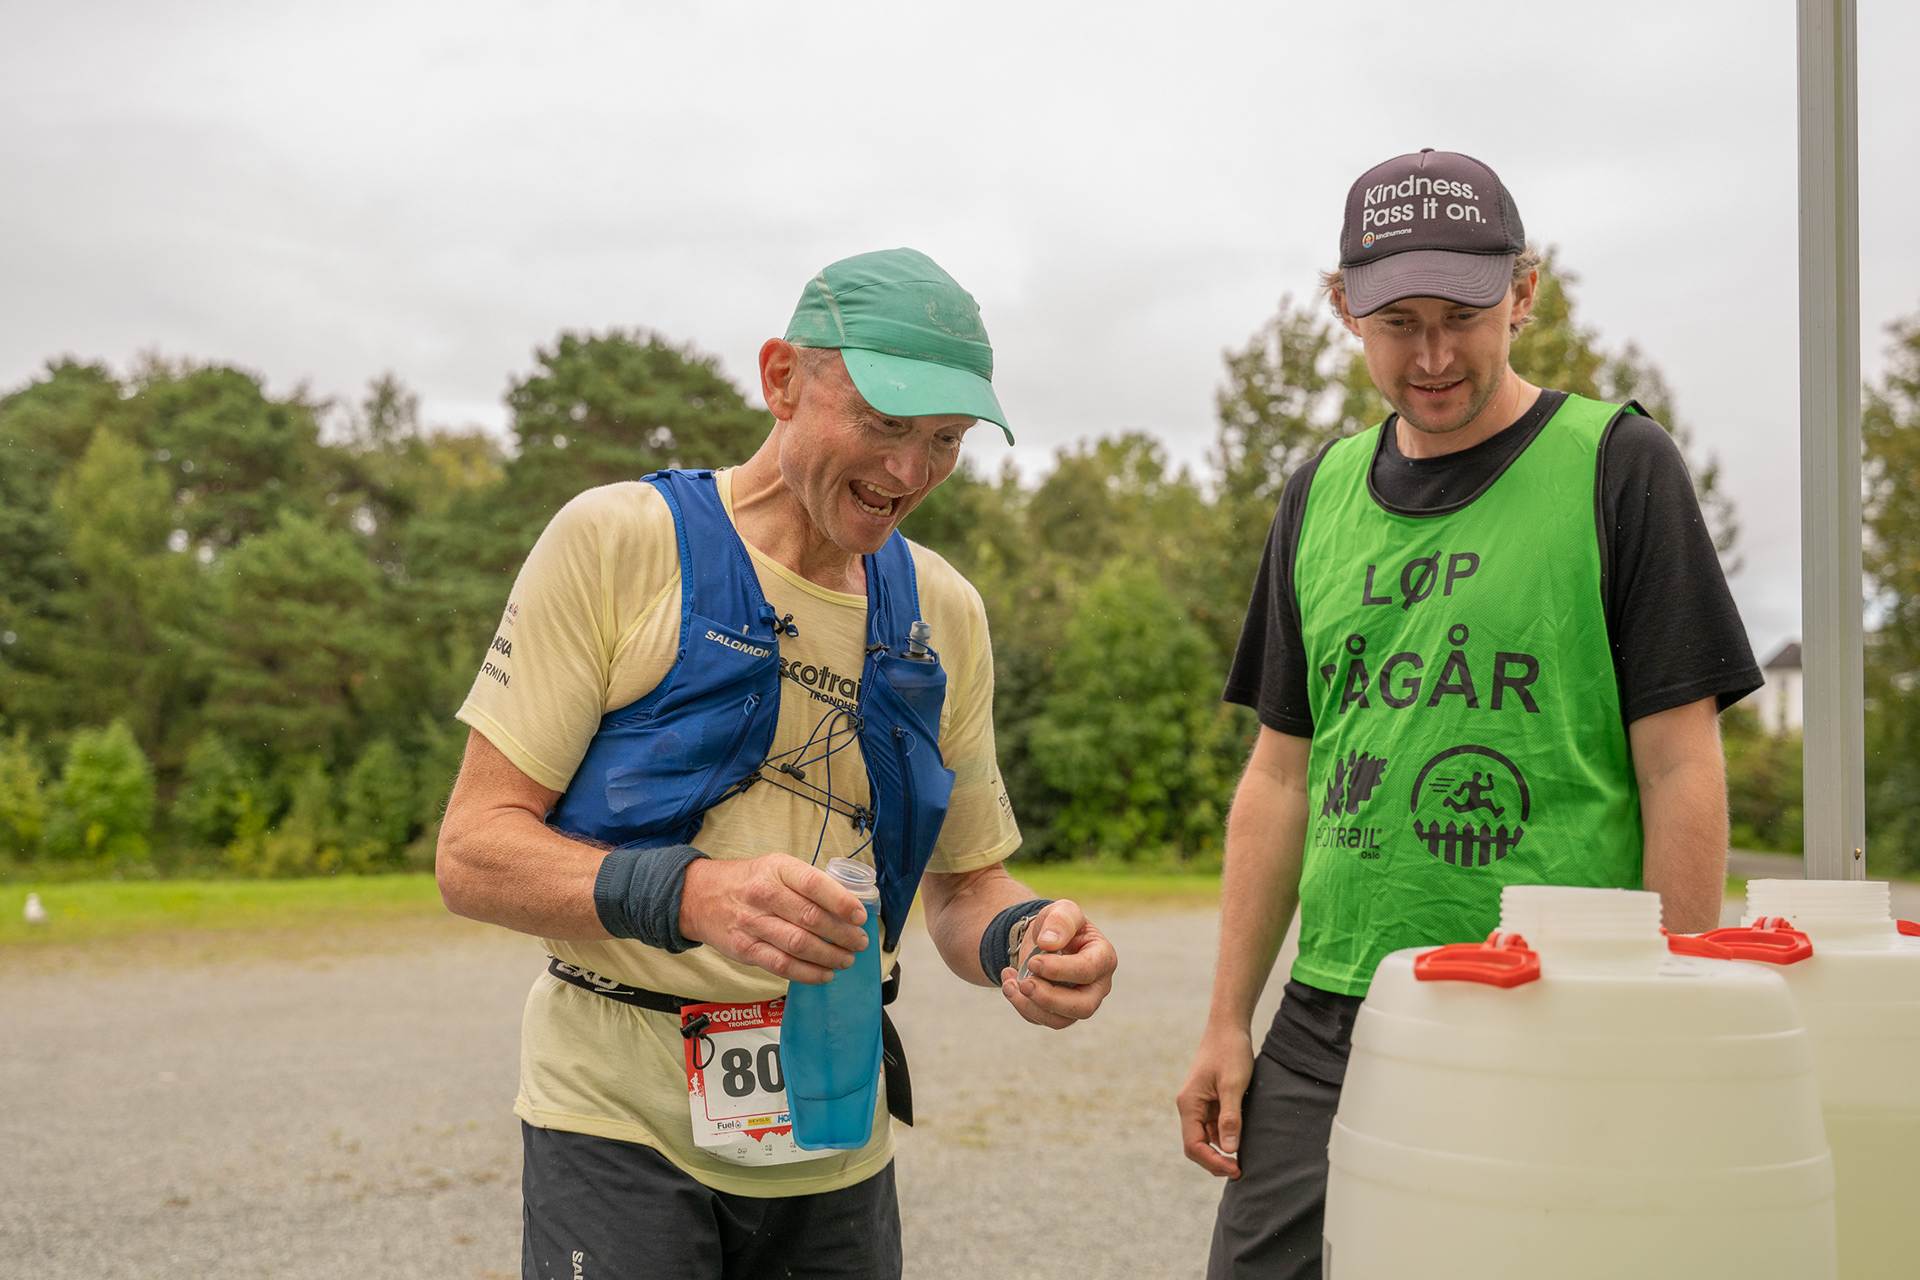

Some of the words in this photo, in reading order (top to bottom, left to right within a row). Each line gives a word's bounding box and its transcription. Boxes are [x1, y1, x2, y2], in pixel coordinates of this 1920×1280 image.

[1363, 175, 1479, 208] Kindness.
[1362, 203, 1414, 231] Pass
[1422, 198, 1438, 219] it
[1446, 203, 1487, 224] on.
[1376, 228, 1412, 240] kindhumans
[1361, 550, 1480, 611] LØP
[705, 630, 773, 659] SALOMON
[1361, 851, 1380, 860] Oslo
[728, 1018, 765, 1028] TRONDHEIM
[717, 1121, 735, 1130] Fuel
